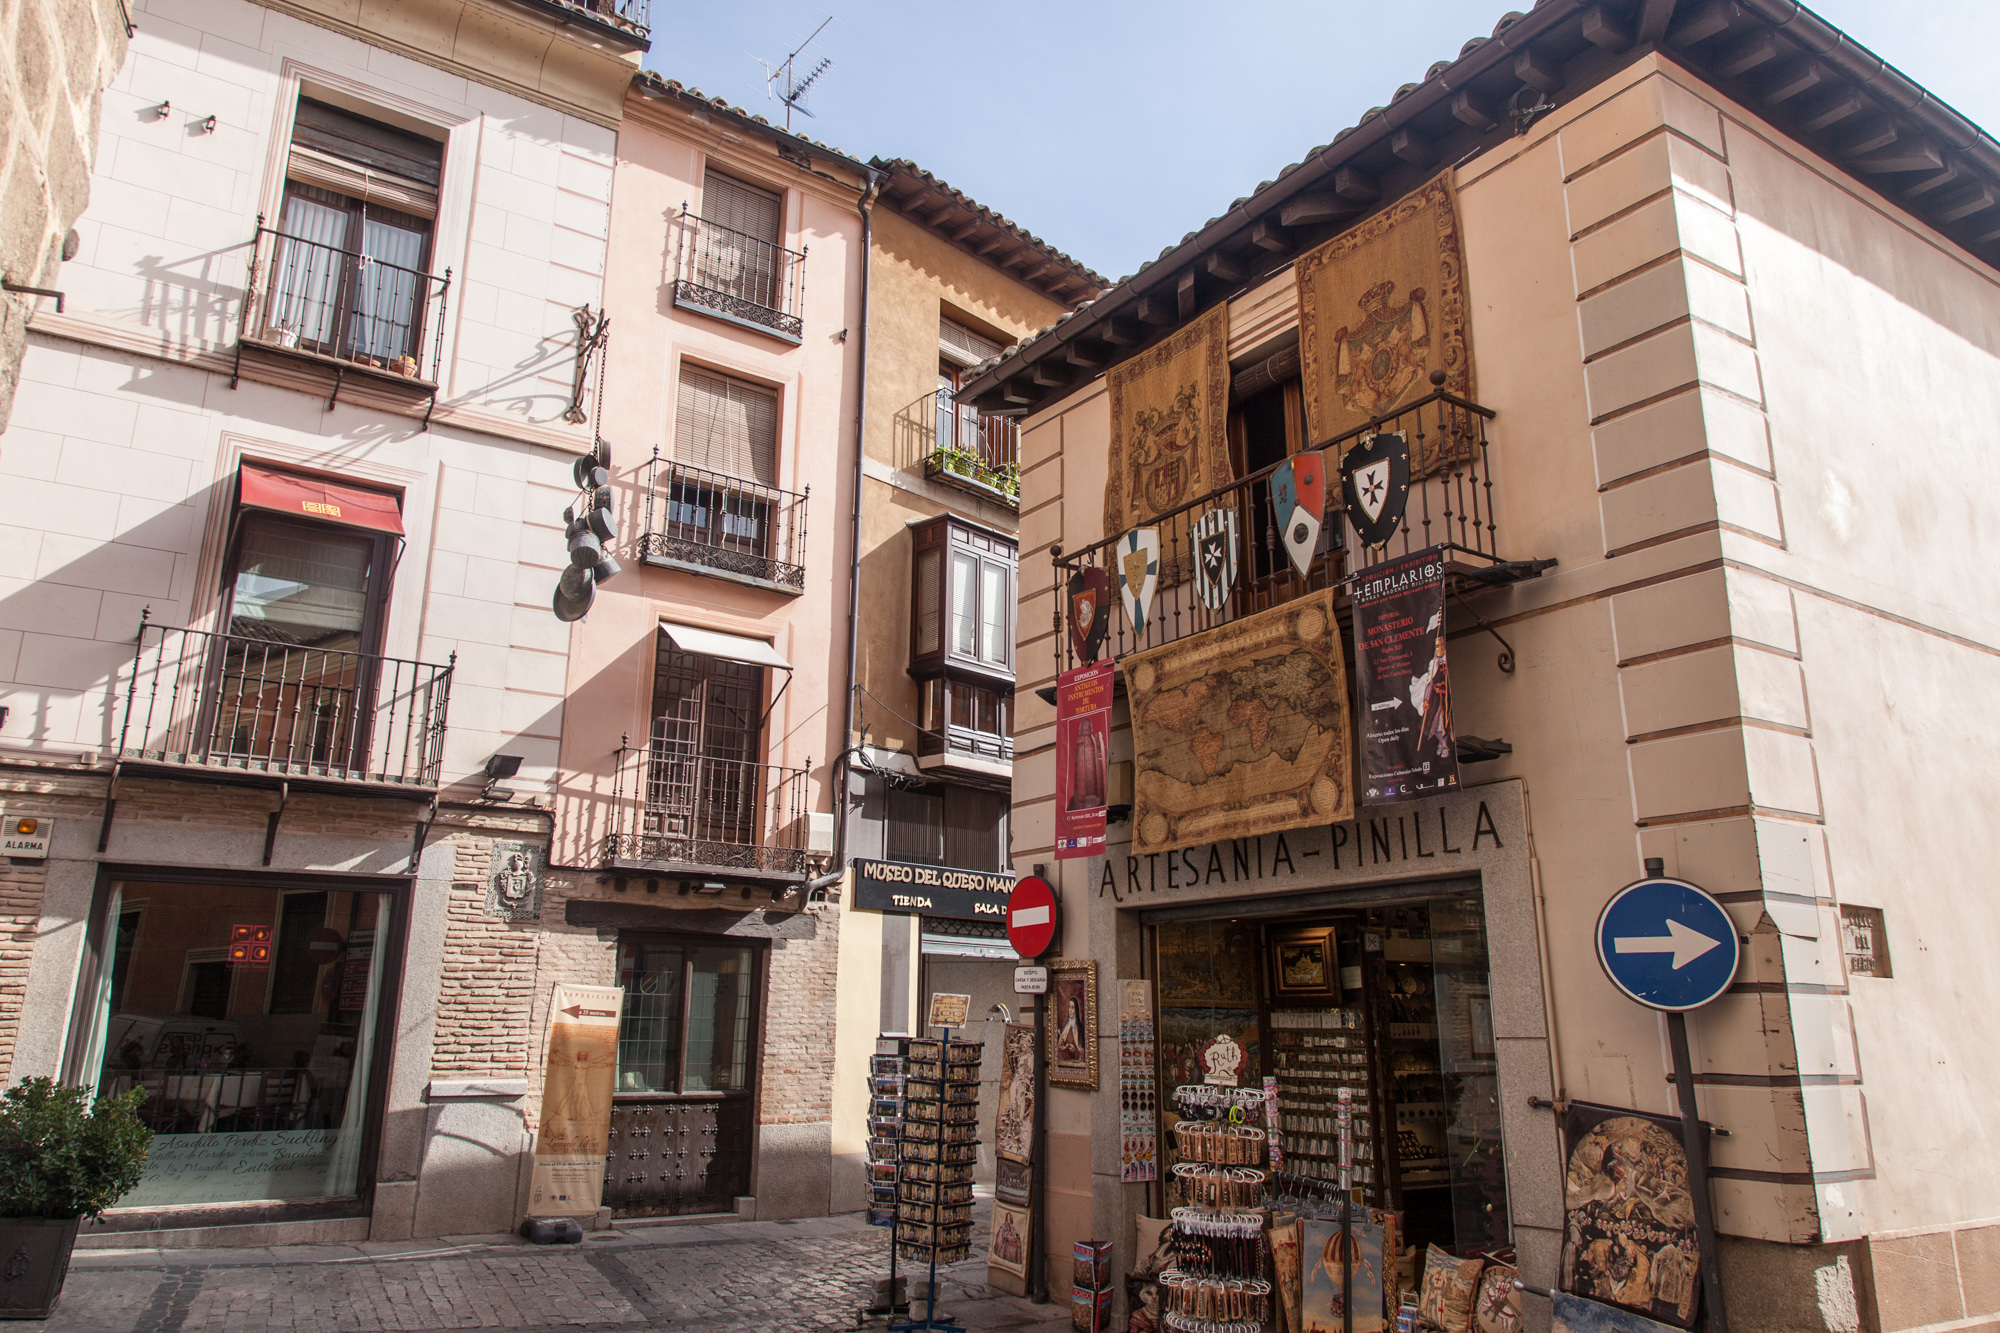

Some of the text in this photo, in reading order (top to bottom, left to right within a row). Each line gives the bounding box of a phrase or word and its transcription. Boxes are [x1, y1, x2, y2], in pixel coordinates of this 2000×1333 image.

[1400, 554, 1438, 570] EXHIBITION
[1354, 561, 1443, 599] TEMPLARIOS
[1378, 611, 1400, 621] IMPERIAL
[1367, 616, 1414, 636] MONASTERIO
[1229, 626, 1281, 649] TERRARVM
[1358, 626, 1425, 651] DE SAN CLEMENTE
[1074, 669, 1099, 682] EXPOSICIÓN
[1067, 685, 1105, 702] INSTRUMENTOS
[1074, 679, 1098, 692] ANTIGUOS
[1075, 703, 1097, 715] TORTURA
[1082, 697, 1090, 705] DE
[5, 840, 43, 850] ALARMA
[1098, 832, 1297, 903] ARTESANIA
[1330, 801, 1504, 870] PINILLA
[863, 862, 1016, 894] MUSEO DEL QUESO MAN
[892, 894, 932, 909] TIENDA
[974, 902, 999, 915] SALA
[1209, 1045, 1239, 1074] Ruth
[224, 1133, 268, 1148] Perdiz
[272, 1129, 338, 1149] Suckling
[184, 1150, 196, 1160] de
[198, 1149, 237, 1160] Cordero
[272, 1147, 323, 1159] Bacalao
[183, 1161, 229, 1171] Mancha
